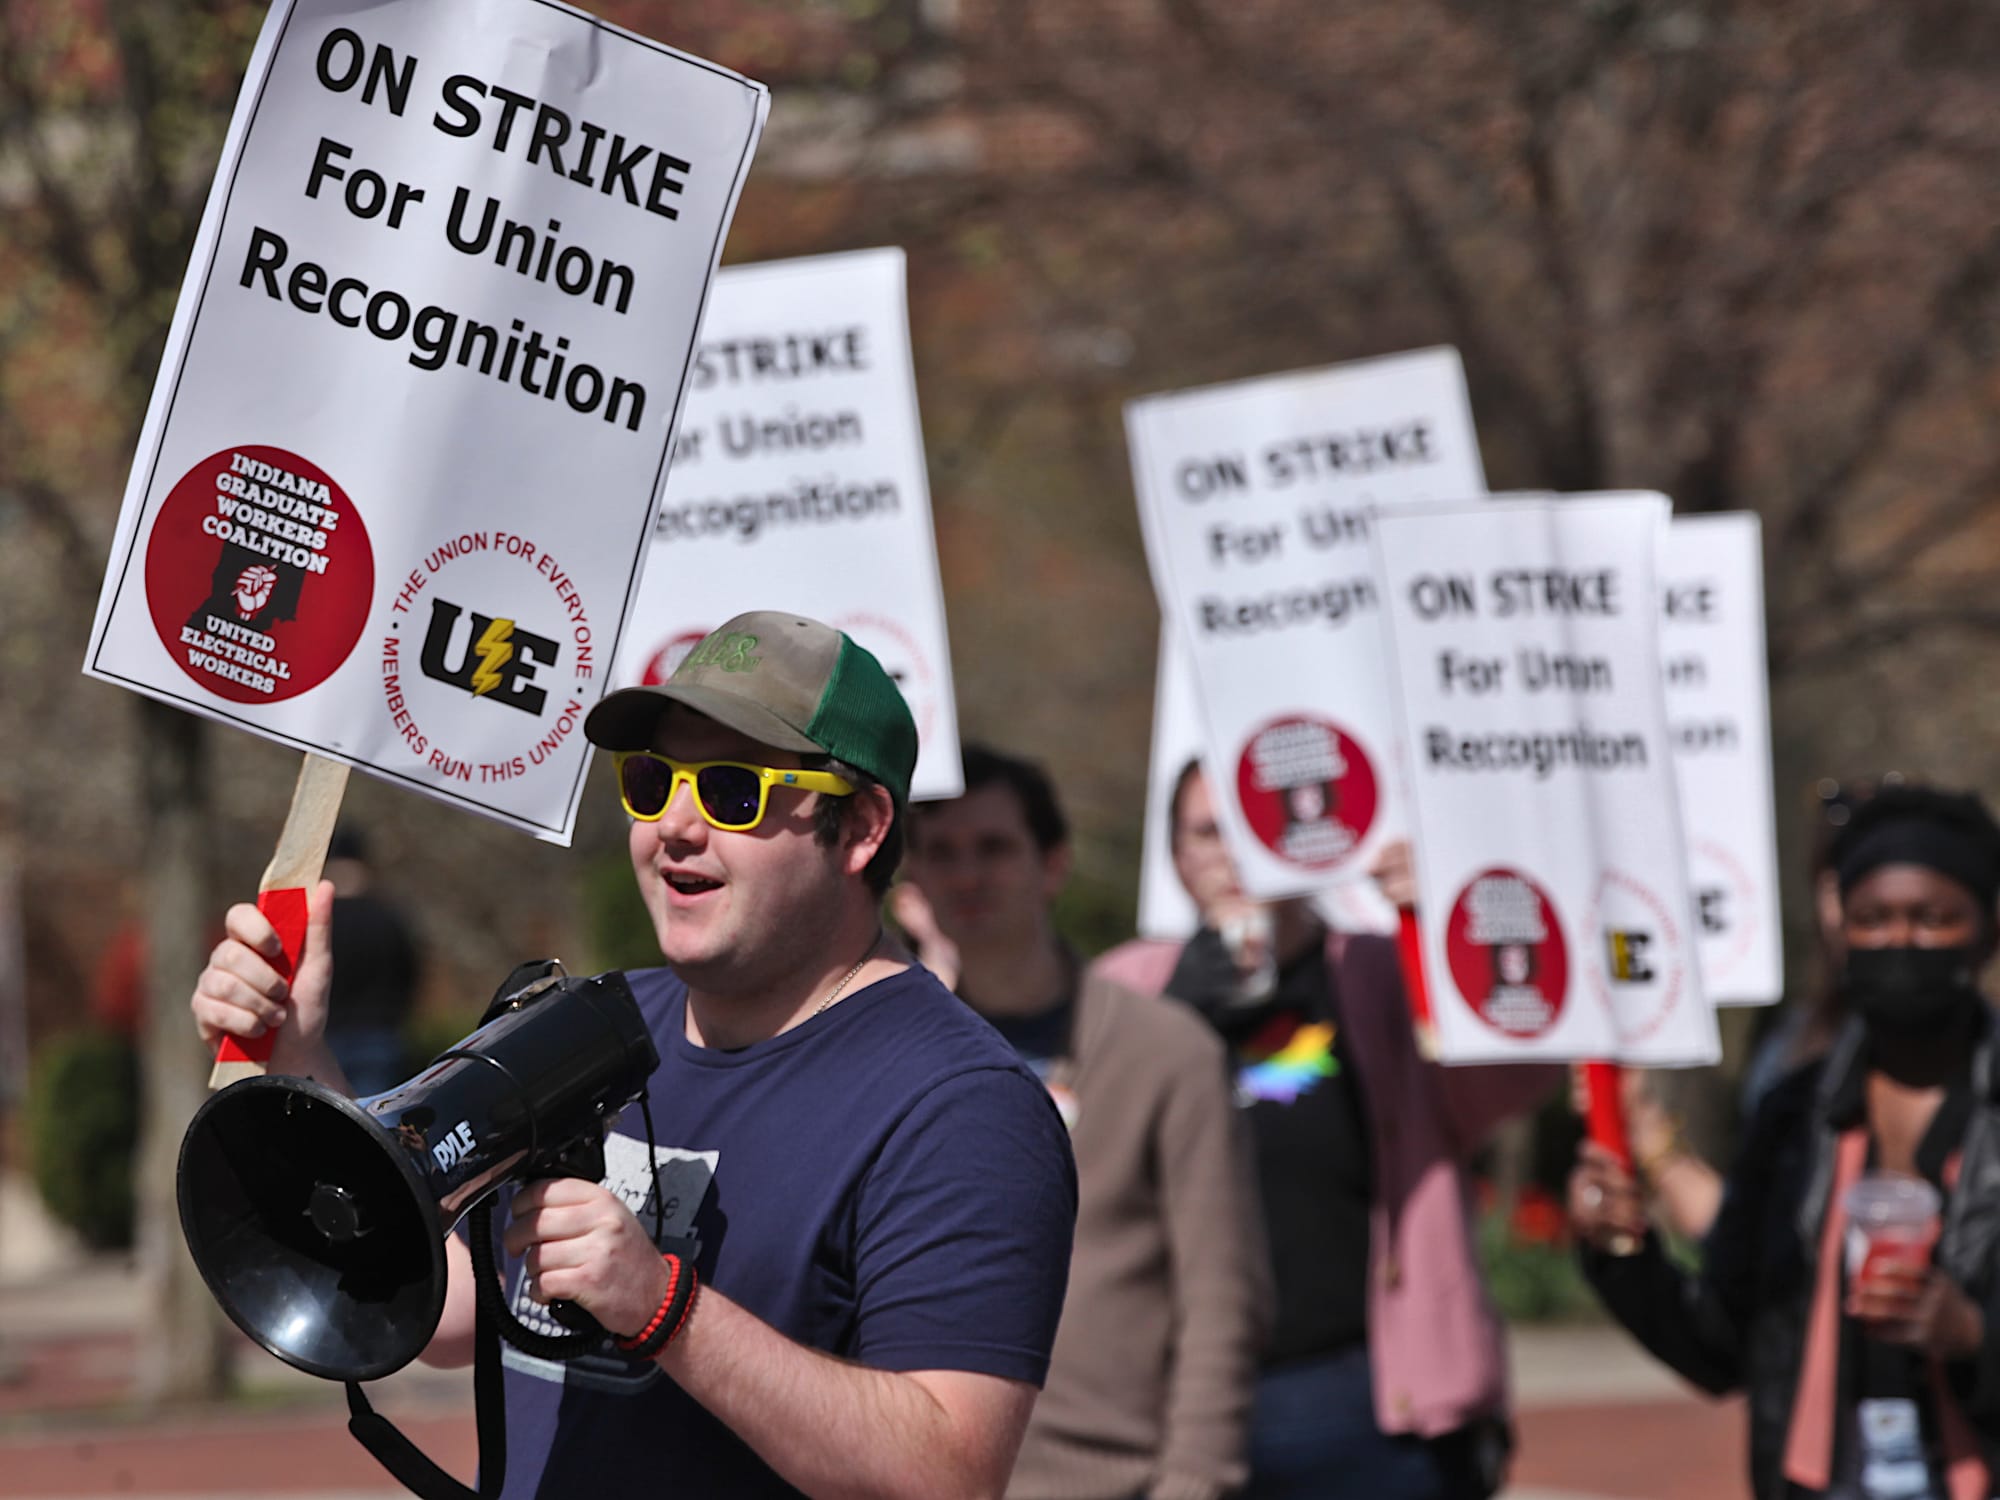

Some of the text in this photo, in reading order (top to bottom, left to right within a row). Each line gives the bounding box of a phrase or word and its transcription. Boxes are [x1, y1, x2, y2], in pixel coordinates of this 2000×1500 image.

[315, 27, 691, 221] ON STRIKE
[305, 137, 635, 315] For Union
[239, 226, 648, 433] Recognition
[720, 408, 863, 459] Union
[230, 453, 332, 505] INDIANA
[1177, 422, 1433, 502] ON STRIKE
[216, 472, 339, 531] GRADUATE
[217, 495, 327, 550] WORKERS
[656, 476, 900, 544] ecognition
[202, 515, 330, 574] COALITION
[1209, 520, 1283, 564] For
[392, 532, 593, 680] THE UNION FOR EVERYONE
[1199, 578, 1377, 634] Recogn
[1410, 573, 1474, 621] ON
[1491, 568, 1617, 617] STRKE
[180, 626, 290, 680] ELECTRICAL
[205, 614, 275, 653] UNITED
[420, 597, 560, 717] UE
[187, 648, 275, 694] WORKERS
[1438, 649, 1503, 695] For
[1517, 650, 1613, 693] Unon
[382, 637, 583, 783] MEMBERS RUN THIS UNION
[1425, 725, 1647, 781] Recognon
[432, 1119, 477, 1173] PYLE
